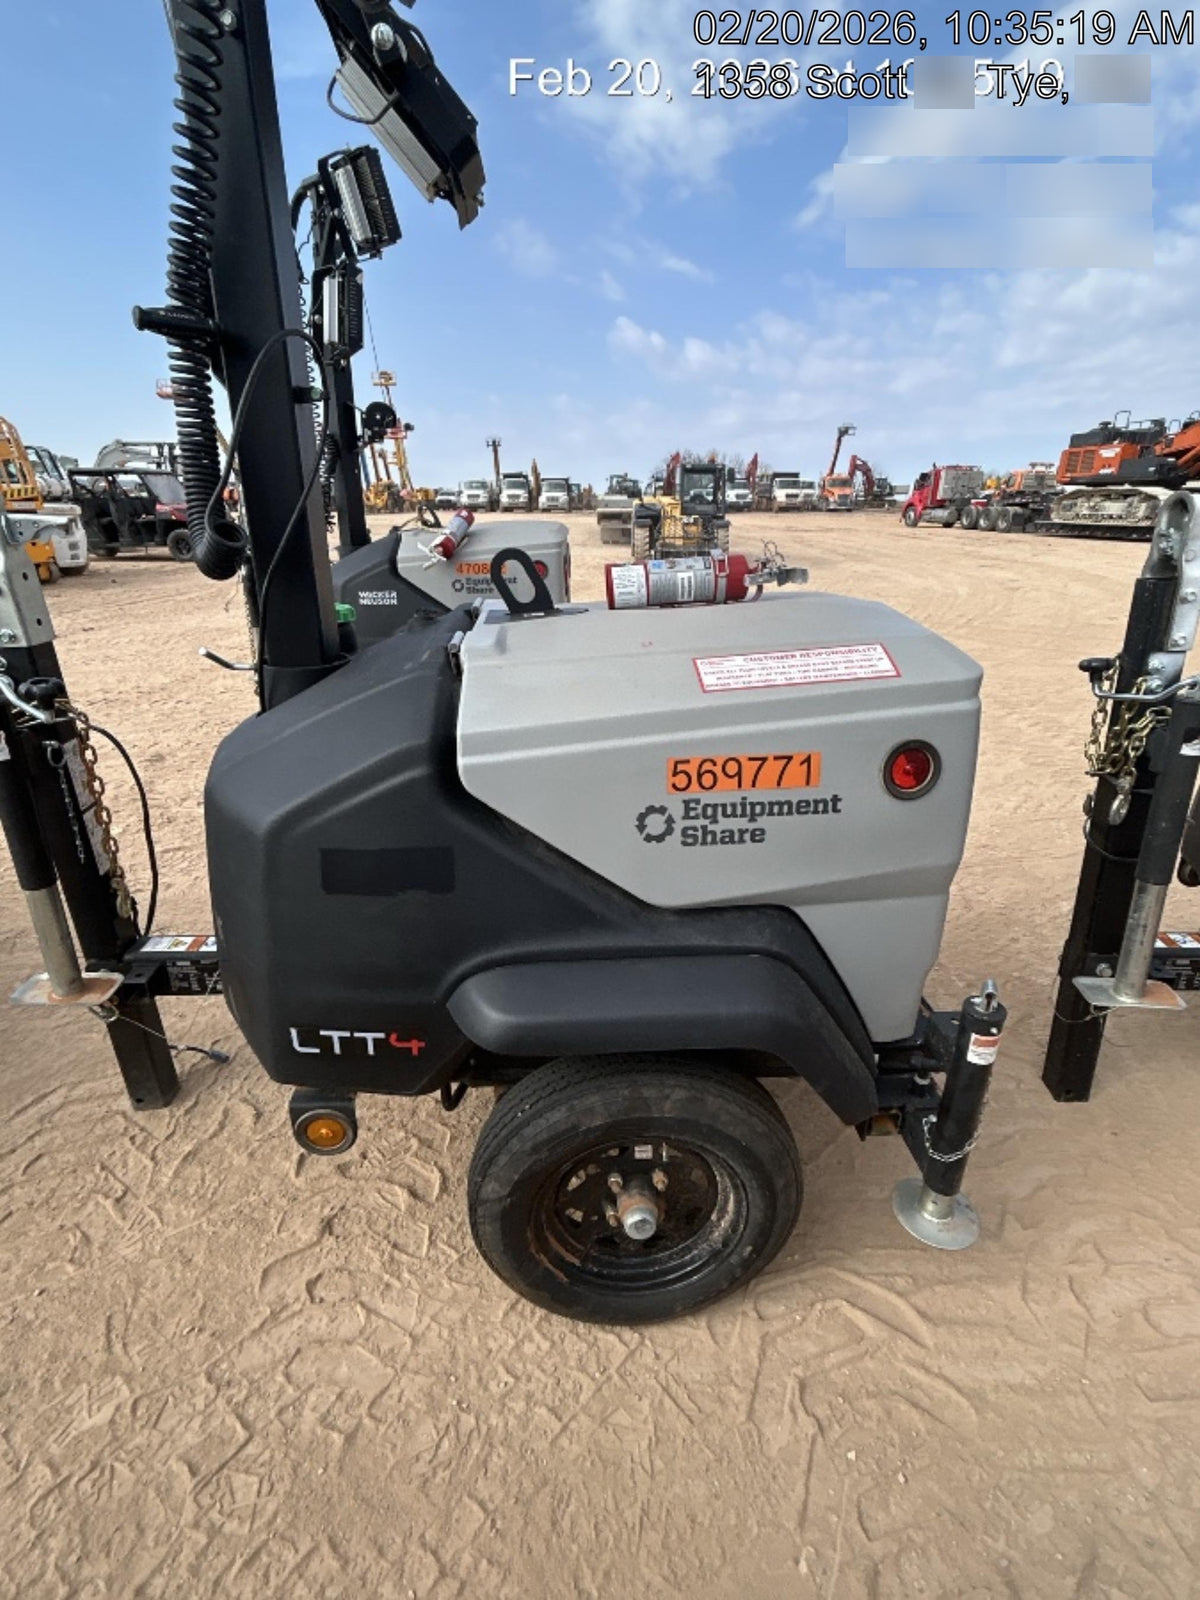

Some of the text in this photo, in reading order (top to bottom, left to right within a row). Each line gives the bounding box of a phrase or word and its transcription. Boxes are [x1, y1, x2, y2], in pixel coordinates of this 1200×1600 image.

[670, 753, 813, 792] 569771
[681, 794, 842, 824] Equipment
[680, 825, 766, 847] Share
[289, 1027, 426, 1056] LTT4
